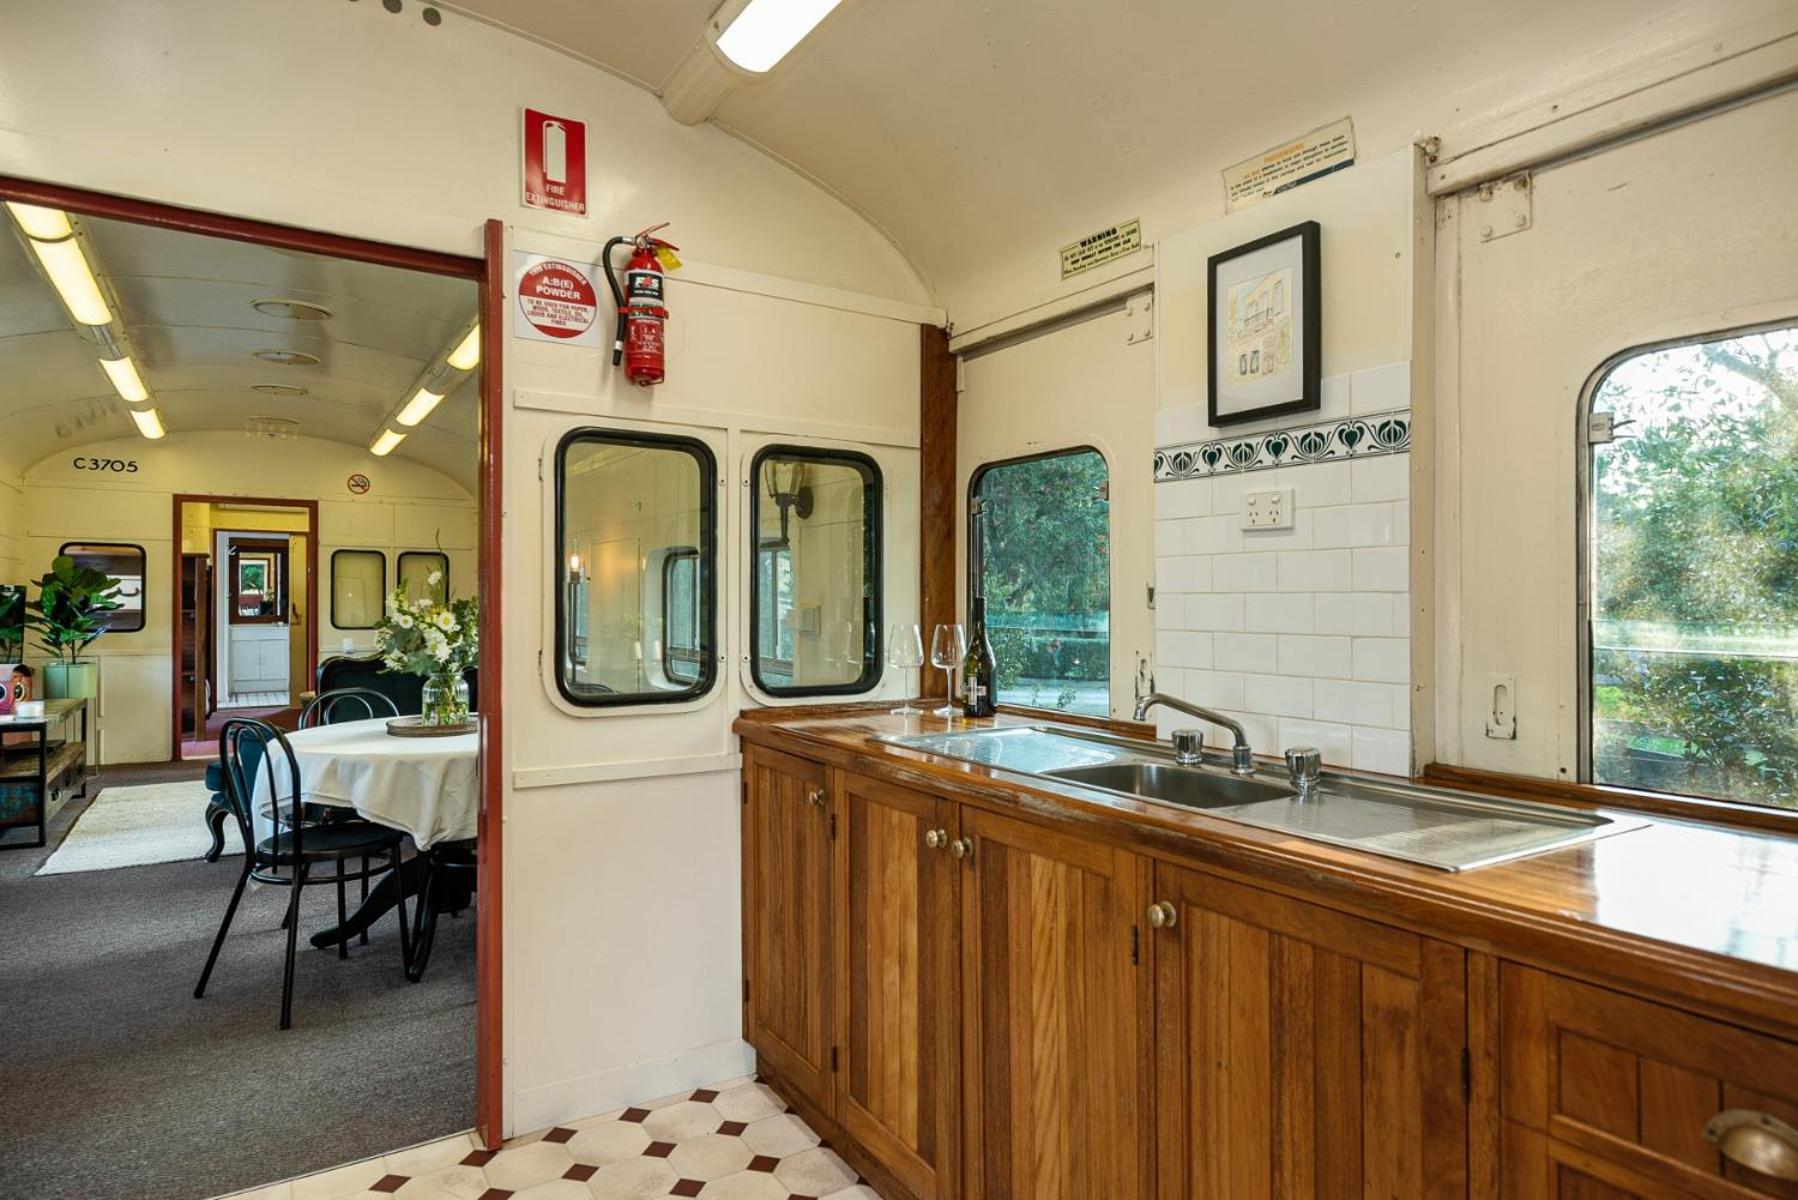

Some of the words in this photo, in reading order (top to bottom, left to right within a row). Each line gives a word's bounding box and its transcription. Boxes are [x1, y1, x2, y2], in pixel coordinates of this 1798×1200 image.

[546, 184, 565, 196] FIRE
[526, 191, 585, 211] EXTINGUISHER
[536, 285, 581, 300] POWDER
